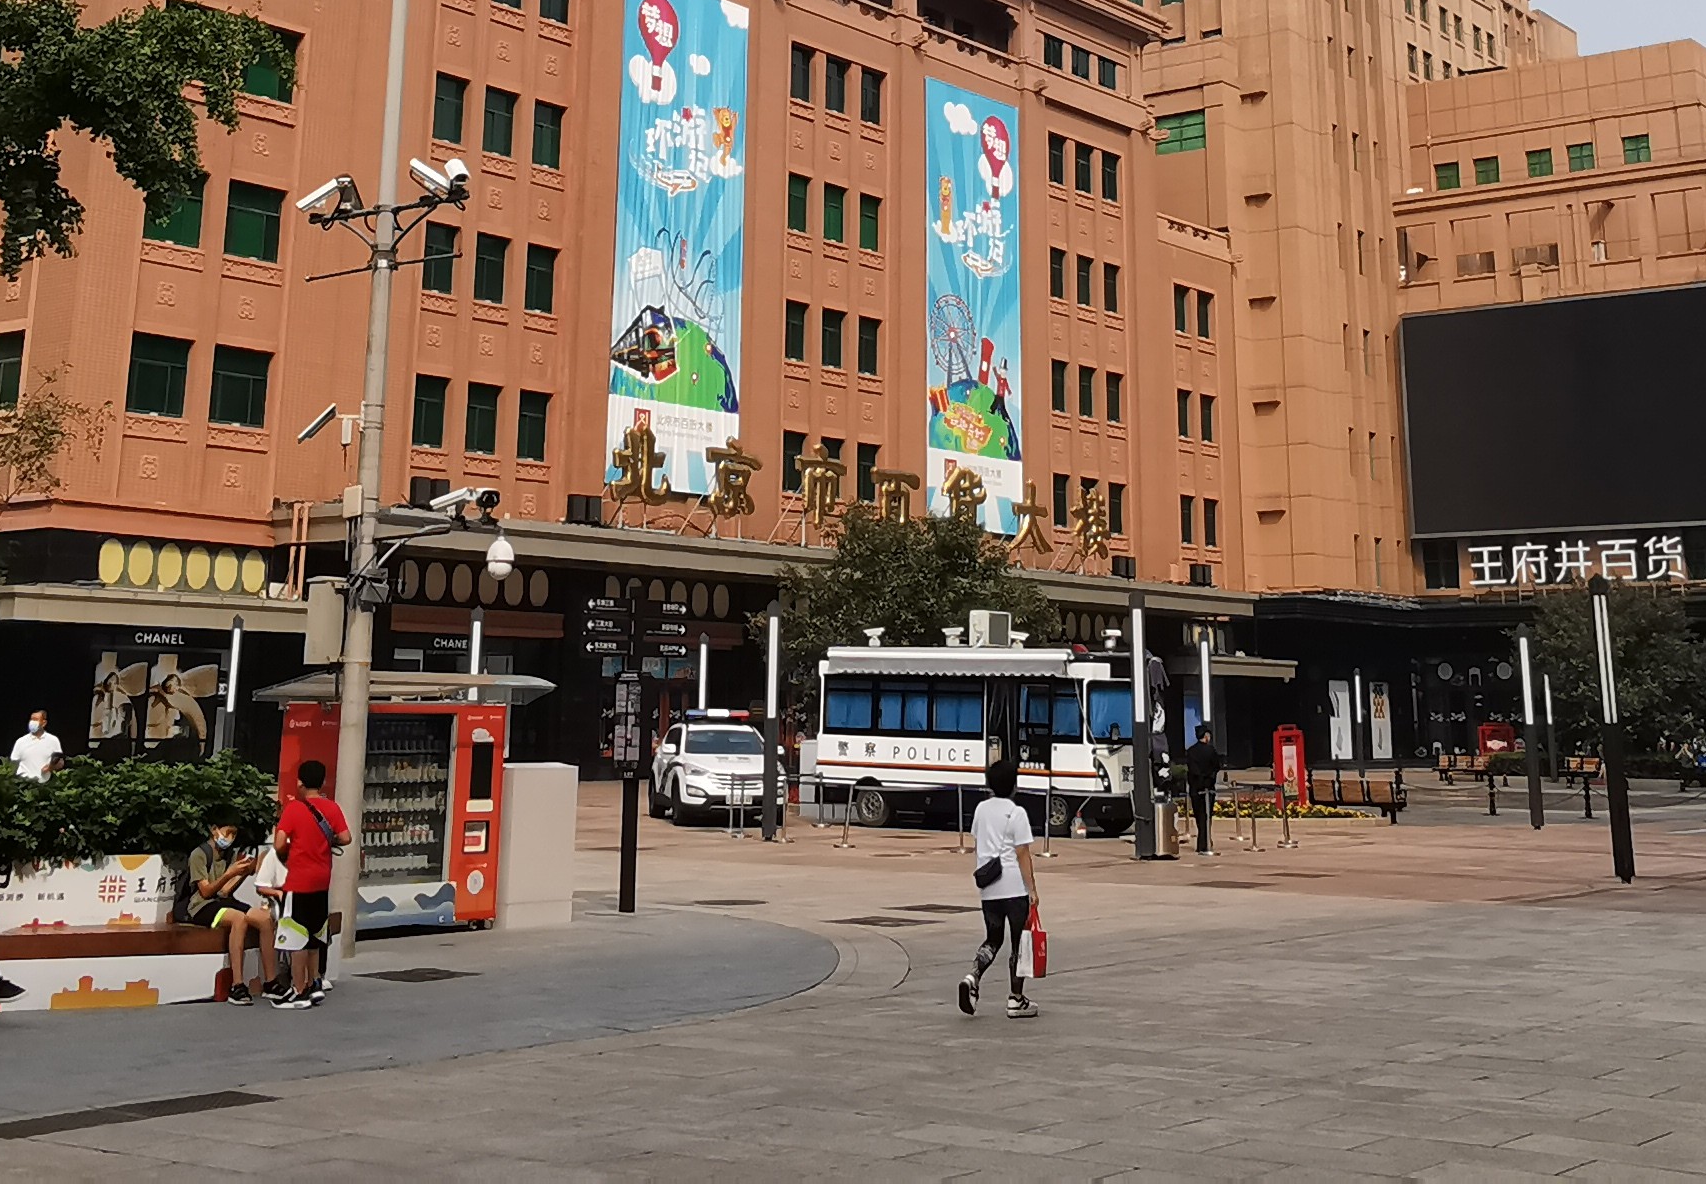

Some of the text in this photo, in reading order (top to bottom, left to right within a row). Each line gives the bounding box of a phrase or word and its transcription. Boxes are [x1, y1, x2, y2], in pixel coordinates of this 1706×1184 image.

[641, 1, 673, 48] 梦想
[610, 424, 1113, 560] 北京市百货大楼
[1467, 534, 1686, 585] 王府井百货
[135, 632, 185, 645] CHANEL
[433, 637, 468, 649] CHANE
[837, 740, 971, 762] 警察 POLICE
